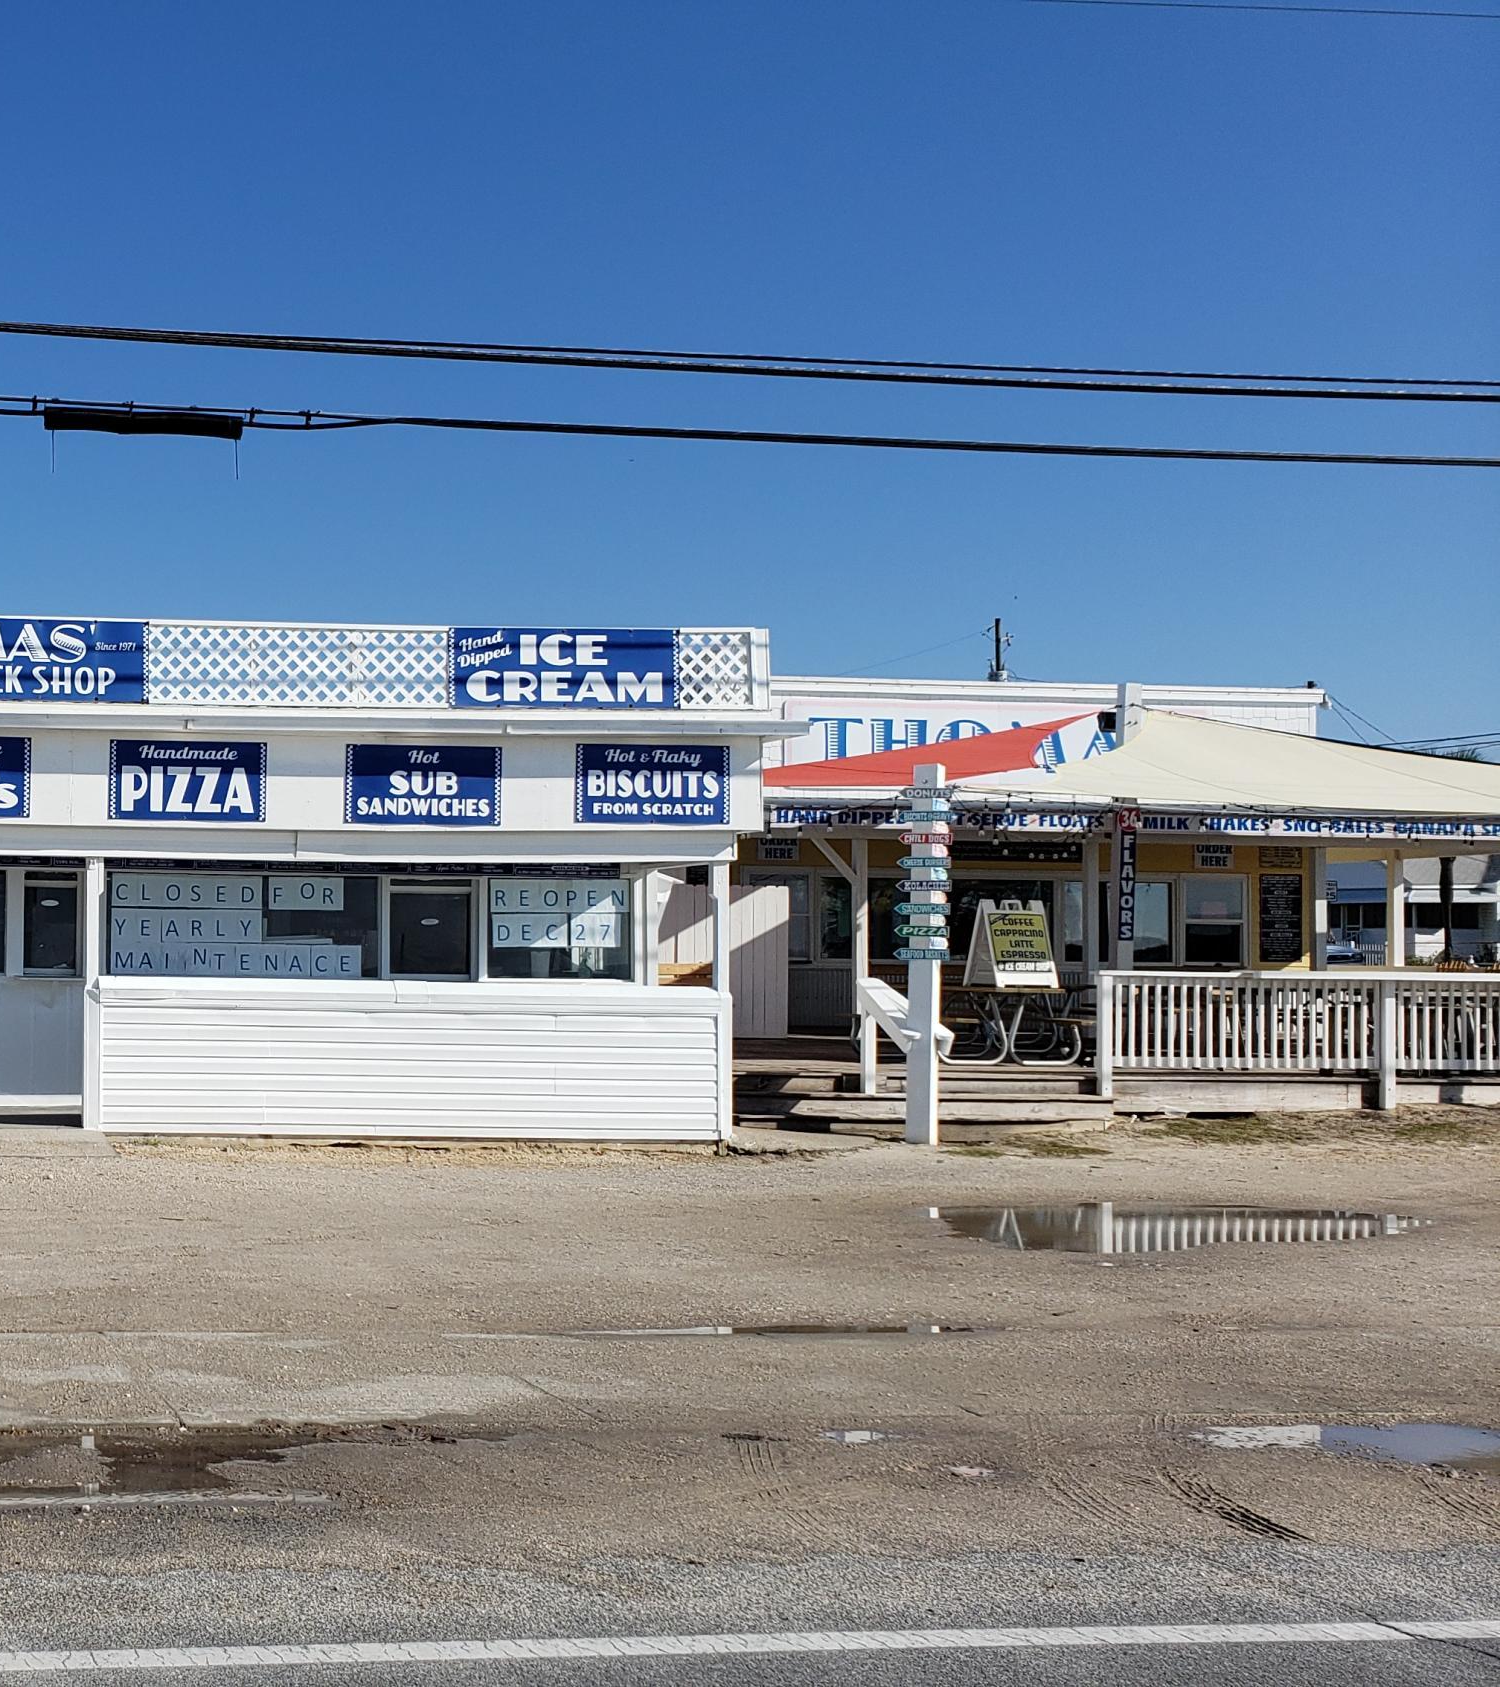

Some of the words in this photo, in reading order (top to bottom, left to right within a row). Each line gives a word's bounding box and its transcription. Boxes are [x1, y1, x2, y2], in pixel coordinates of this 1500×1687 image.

[95, 641, 118, 651] Since
[119, 642, 136, 652] 1971
[458, 630, 504, 652] Hand
[457, 645, 512, 668] Dipped
[519, 634, 608, 666] ICE
[32, 666, 116, 695] SHOP
[466, 670, 663, 703] CREAM
[138, 745, 238, 761] Handmade
[408, 750, 441, 764] Hot
[605, 749, 636, 763] Hot
[640, 752, 650, 763] &
[652, 750, 702, 767] Flaky
[121, 765, 254, 813] PIZZA
[389, 770, 458, 796] SUB
[587, 769, 719, 799] BISCUITS
[906, 789, 950, 798] DONUTS
[357, 797, 490, 817] SANDWICHES
[593, 803, 638, 815] FROM
[642, 803, 713, 816] SCRATCH
[776, 808, 832, 824] HAND
[838, 810, 908, 825] DIPPE
[970, 813, 1028, 827] SERVE
[1039, 813, 1105, 828] FLOATS
[1121, 810, 1137, 827] 36
[1142, 816, 1190, 830] MILK
[1198, 816, 1270, 831] SHAKES
[760, 838, 797, 846] ORDER
[904, 835, 925, 843] CHILI
[928, 835, 950, 843] DOGS
[764, 847, 793, 859] HERE
[1196, 844, 1233, 854] ORDER
[1201, 856, 1228, 867] HERE
[115, 883, 254, 903] CLOSED
[273, 882, 334, 905] FOR
[904, 882, 949, 890] KOLACHES
[1120, 835, 1135, 939] FLAVORS
[494, 889, 625, 907] REOPEN
[902, 905, 948, 914] SANDWICHES
[114, 918, 252, 937] YEARLY
[1002, 918, 1035, 927] COFFEE
[497, 924, 558, 942] DEC
[575, 924, 611, 942] 27
[903, 927, 947, 936] PIZZA
[994, 929, 1044, 938] CAPPACINO
[1010, 940, 1035, 949] LATTE
[114, 948, 351, 972] MAINTENACE
[1001, 950, 1046, 959] ESPRESSO
